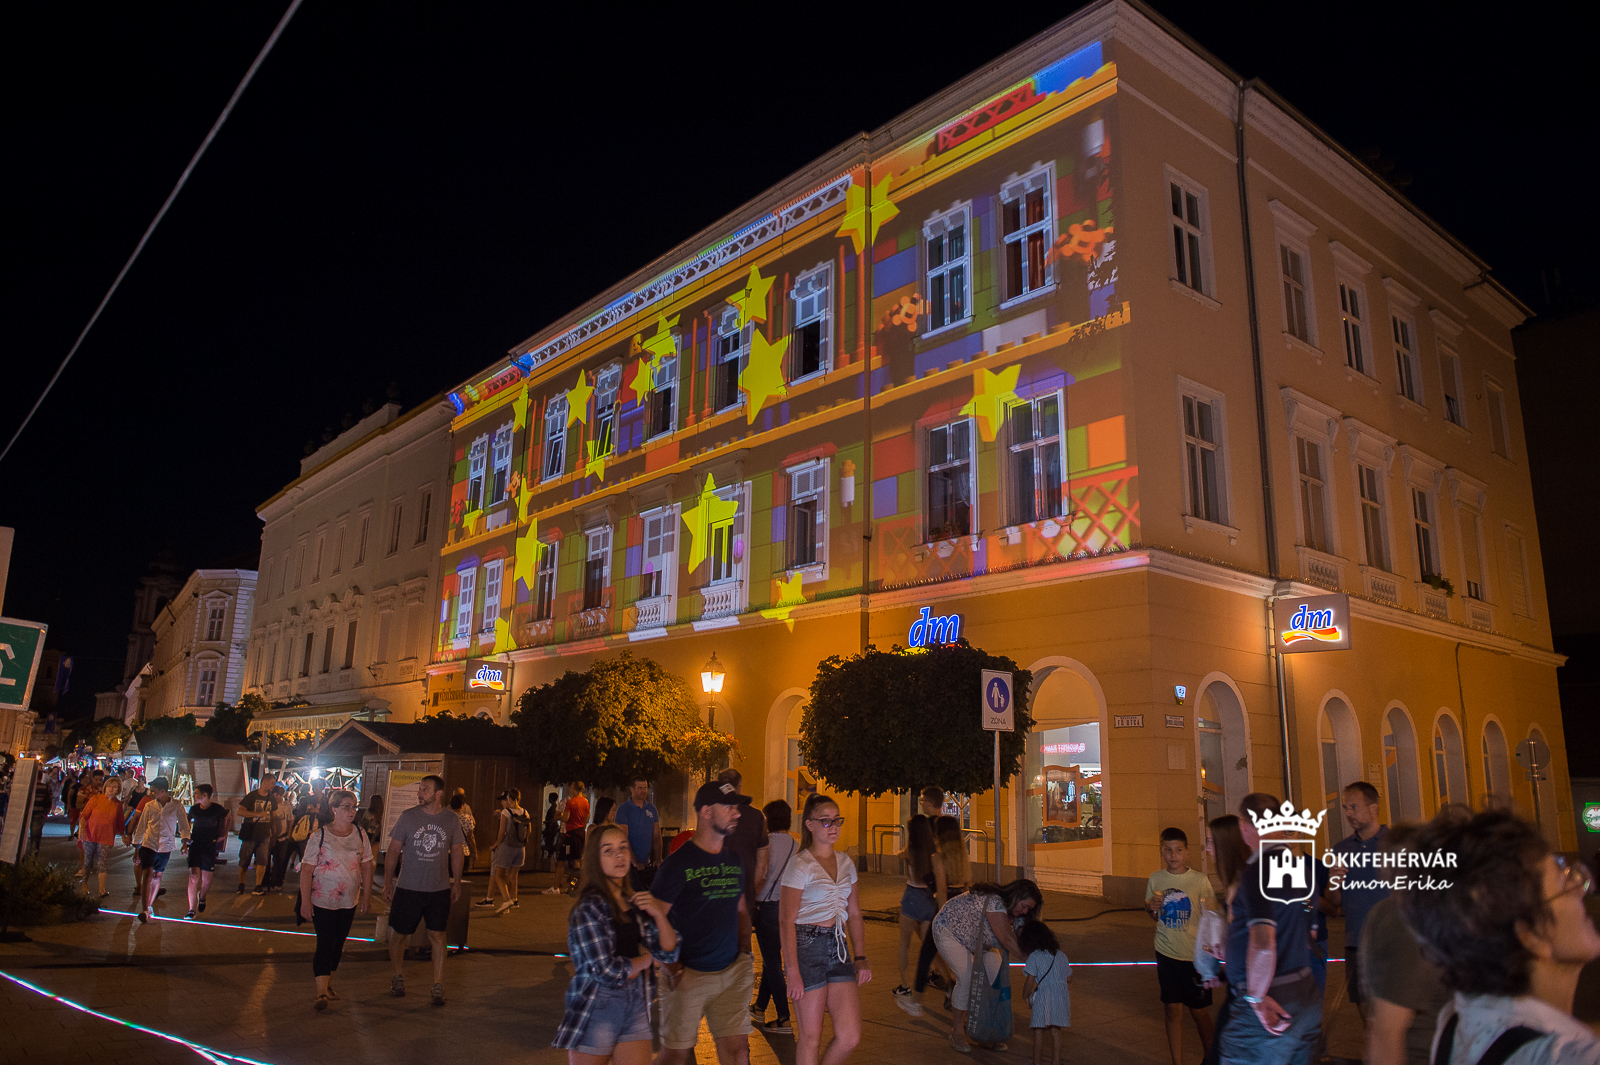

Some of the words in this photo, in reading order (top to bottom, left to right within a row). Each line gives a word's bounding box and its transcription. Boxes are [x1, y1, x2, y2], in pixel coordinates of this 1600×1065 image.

[1290, 603, 1334, 631] dm
[908, 606, 960, 648] dm
[476, 664, 502, 681] dm
[990, 716, 1006, 724] ZÓNA
[427, 823, 447, 841] DIVISION
[684, 867, 720, 882] Retro
[1176, 909, 1189, 919] THE
